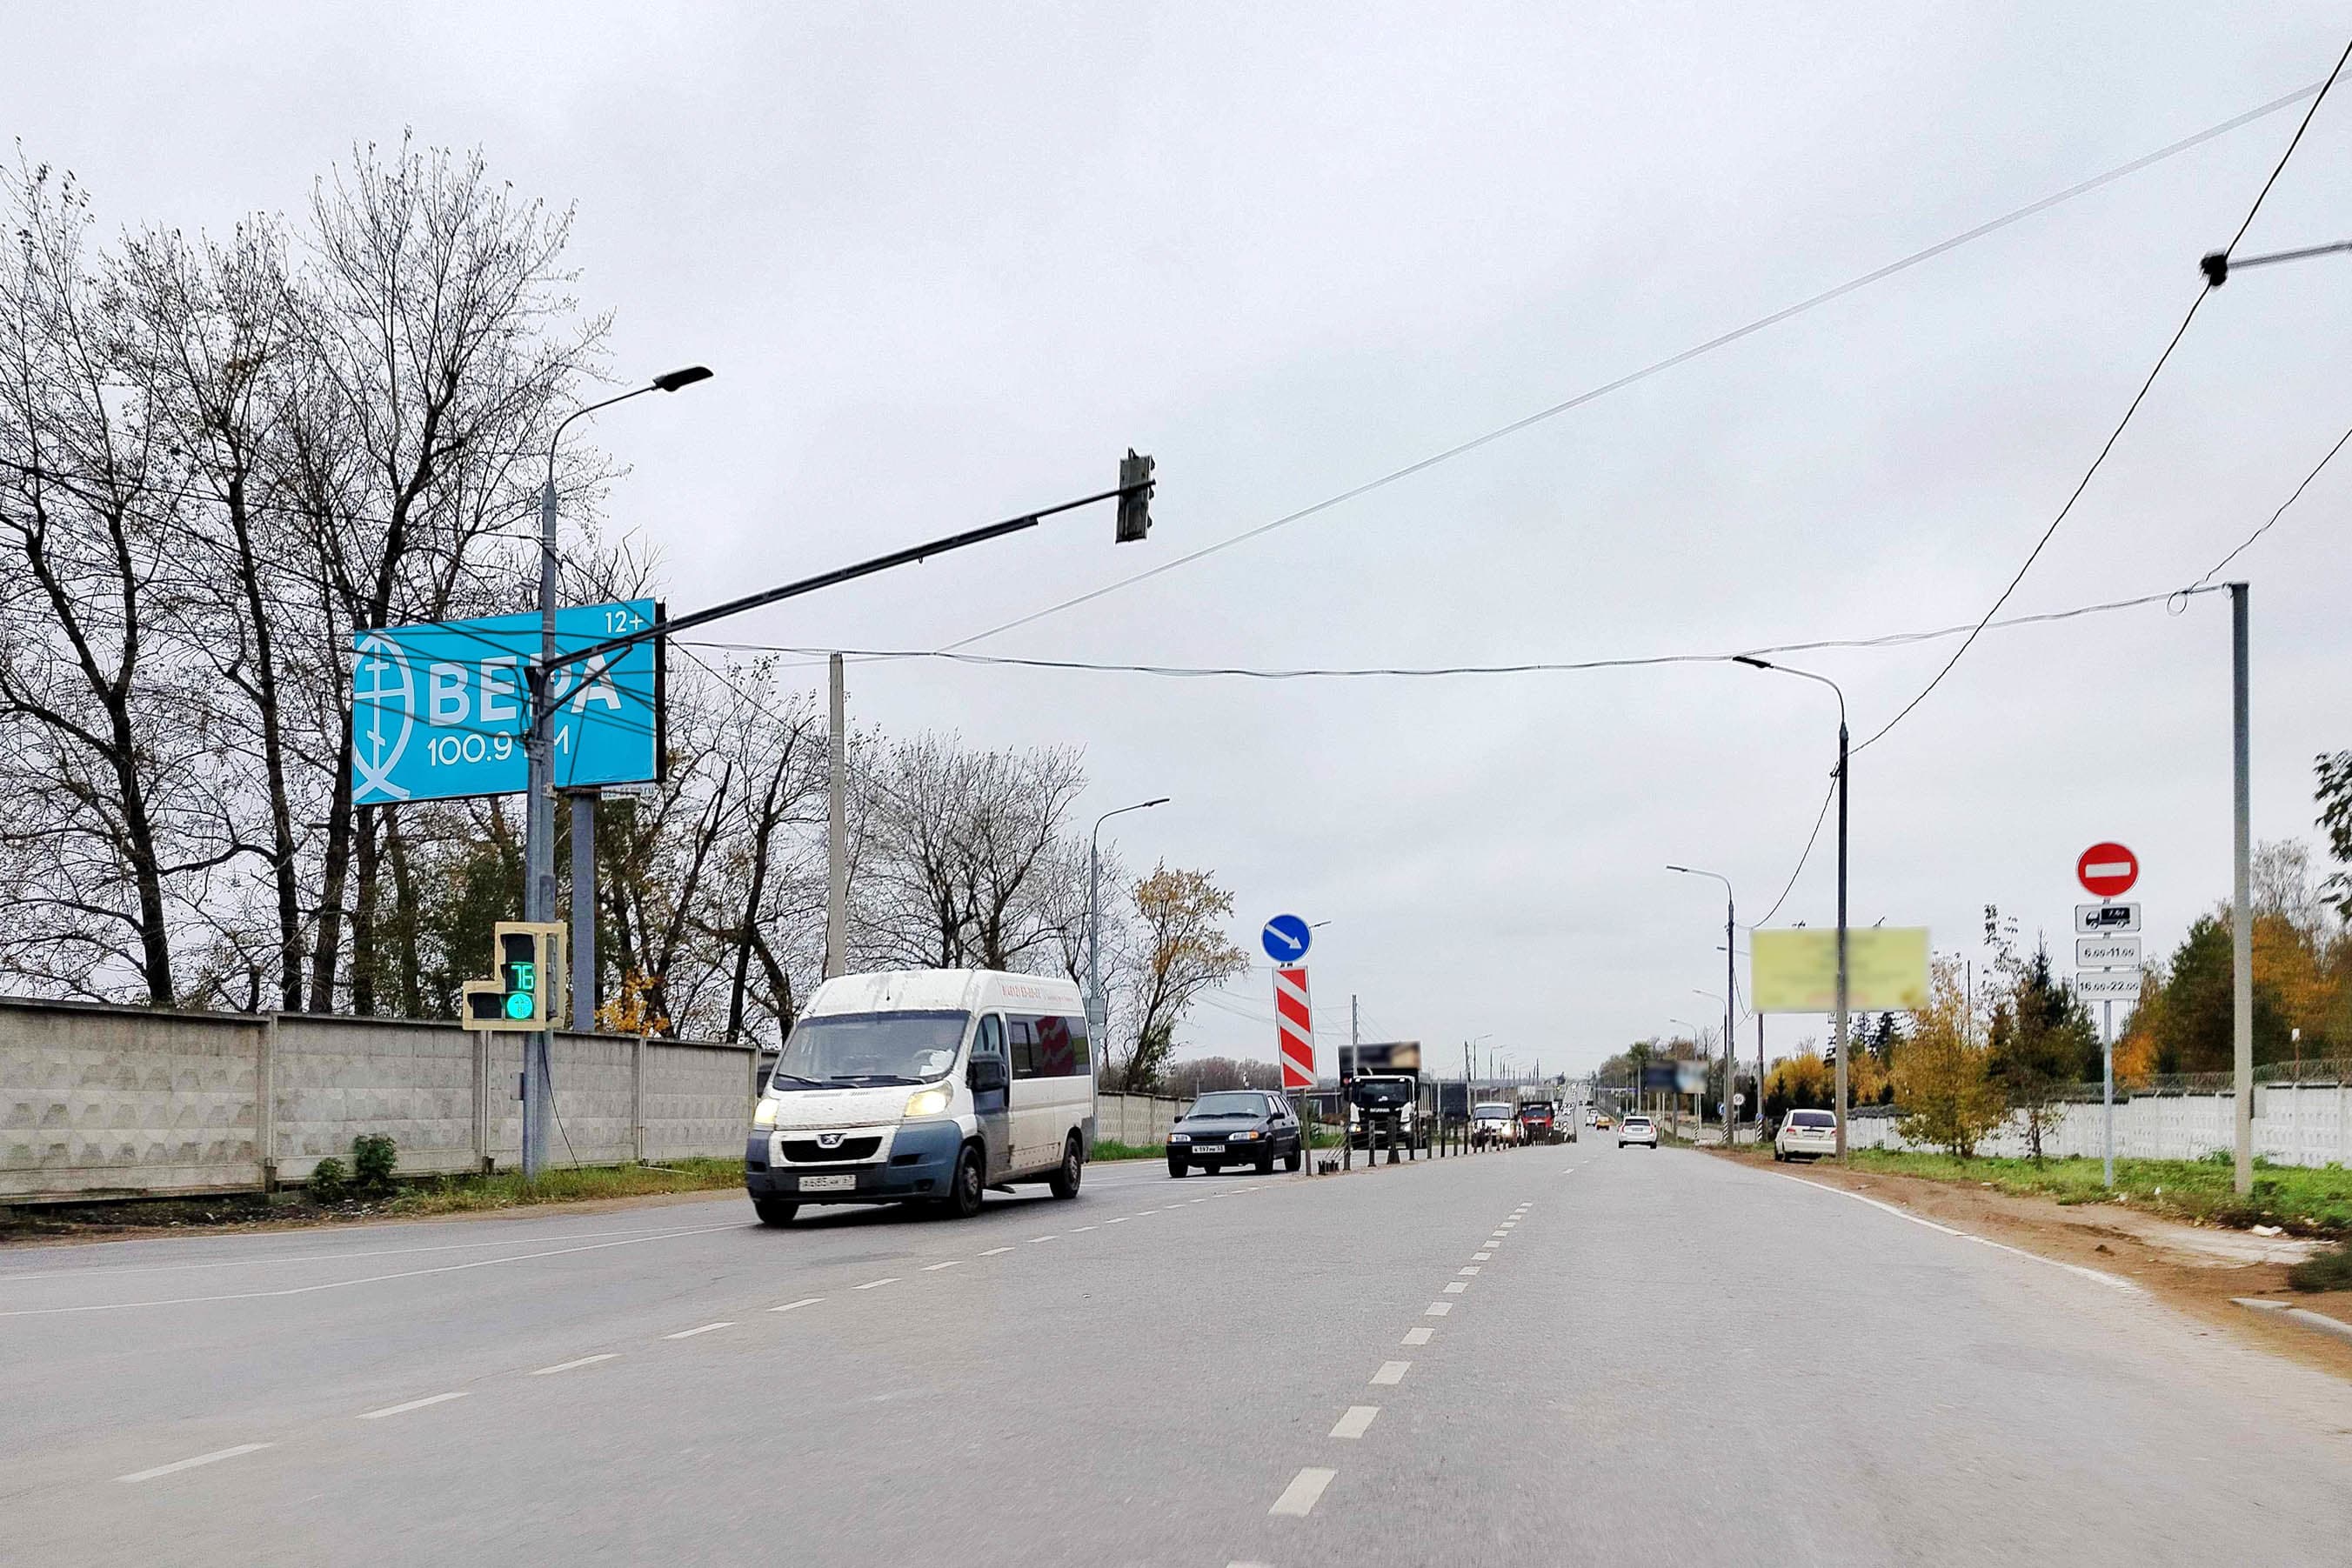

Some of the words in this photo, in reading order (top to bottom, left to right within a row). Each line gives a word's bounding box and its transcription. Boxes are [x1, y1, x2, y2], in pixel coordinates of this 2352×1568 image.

[605, 611, 645, 634] 12+
[426, 730, 513, 767] 100.9
[511, 964, 534, 990] 76
